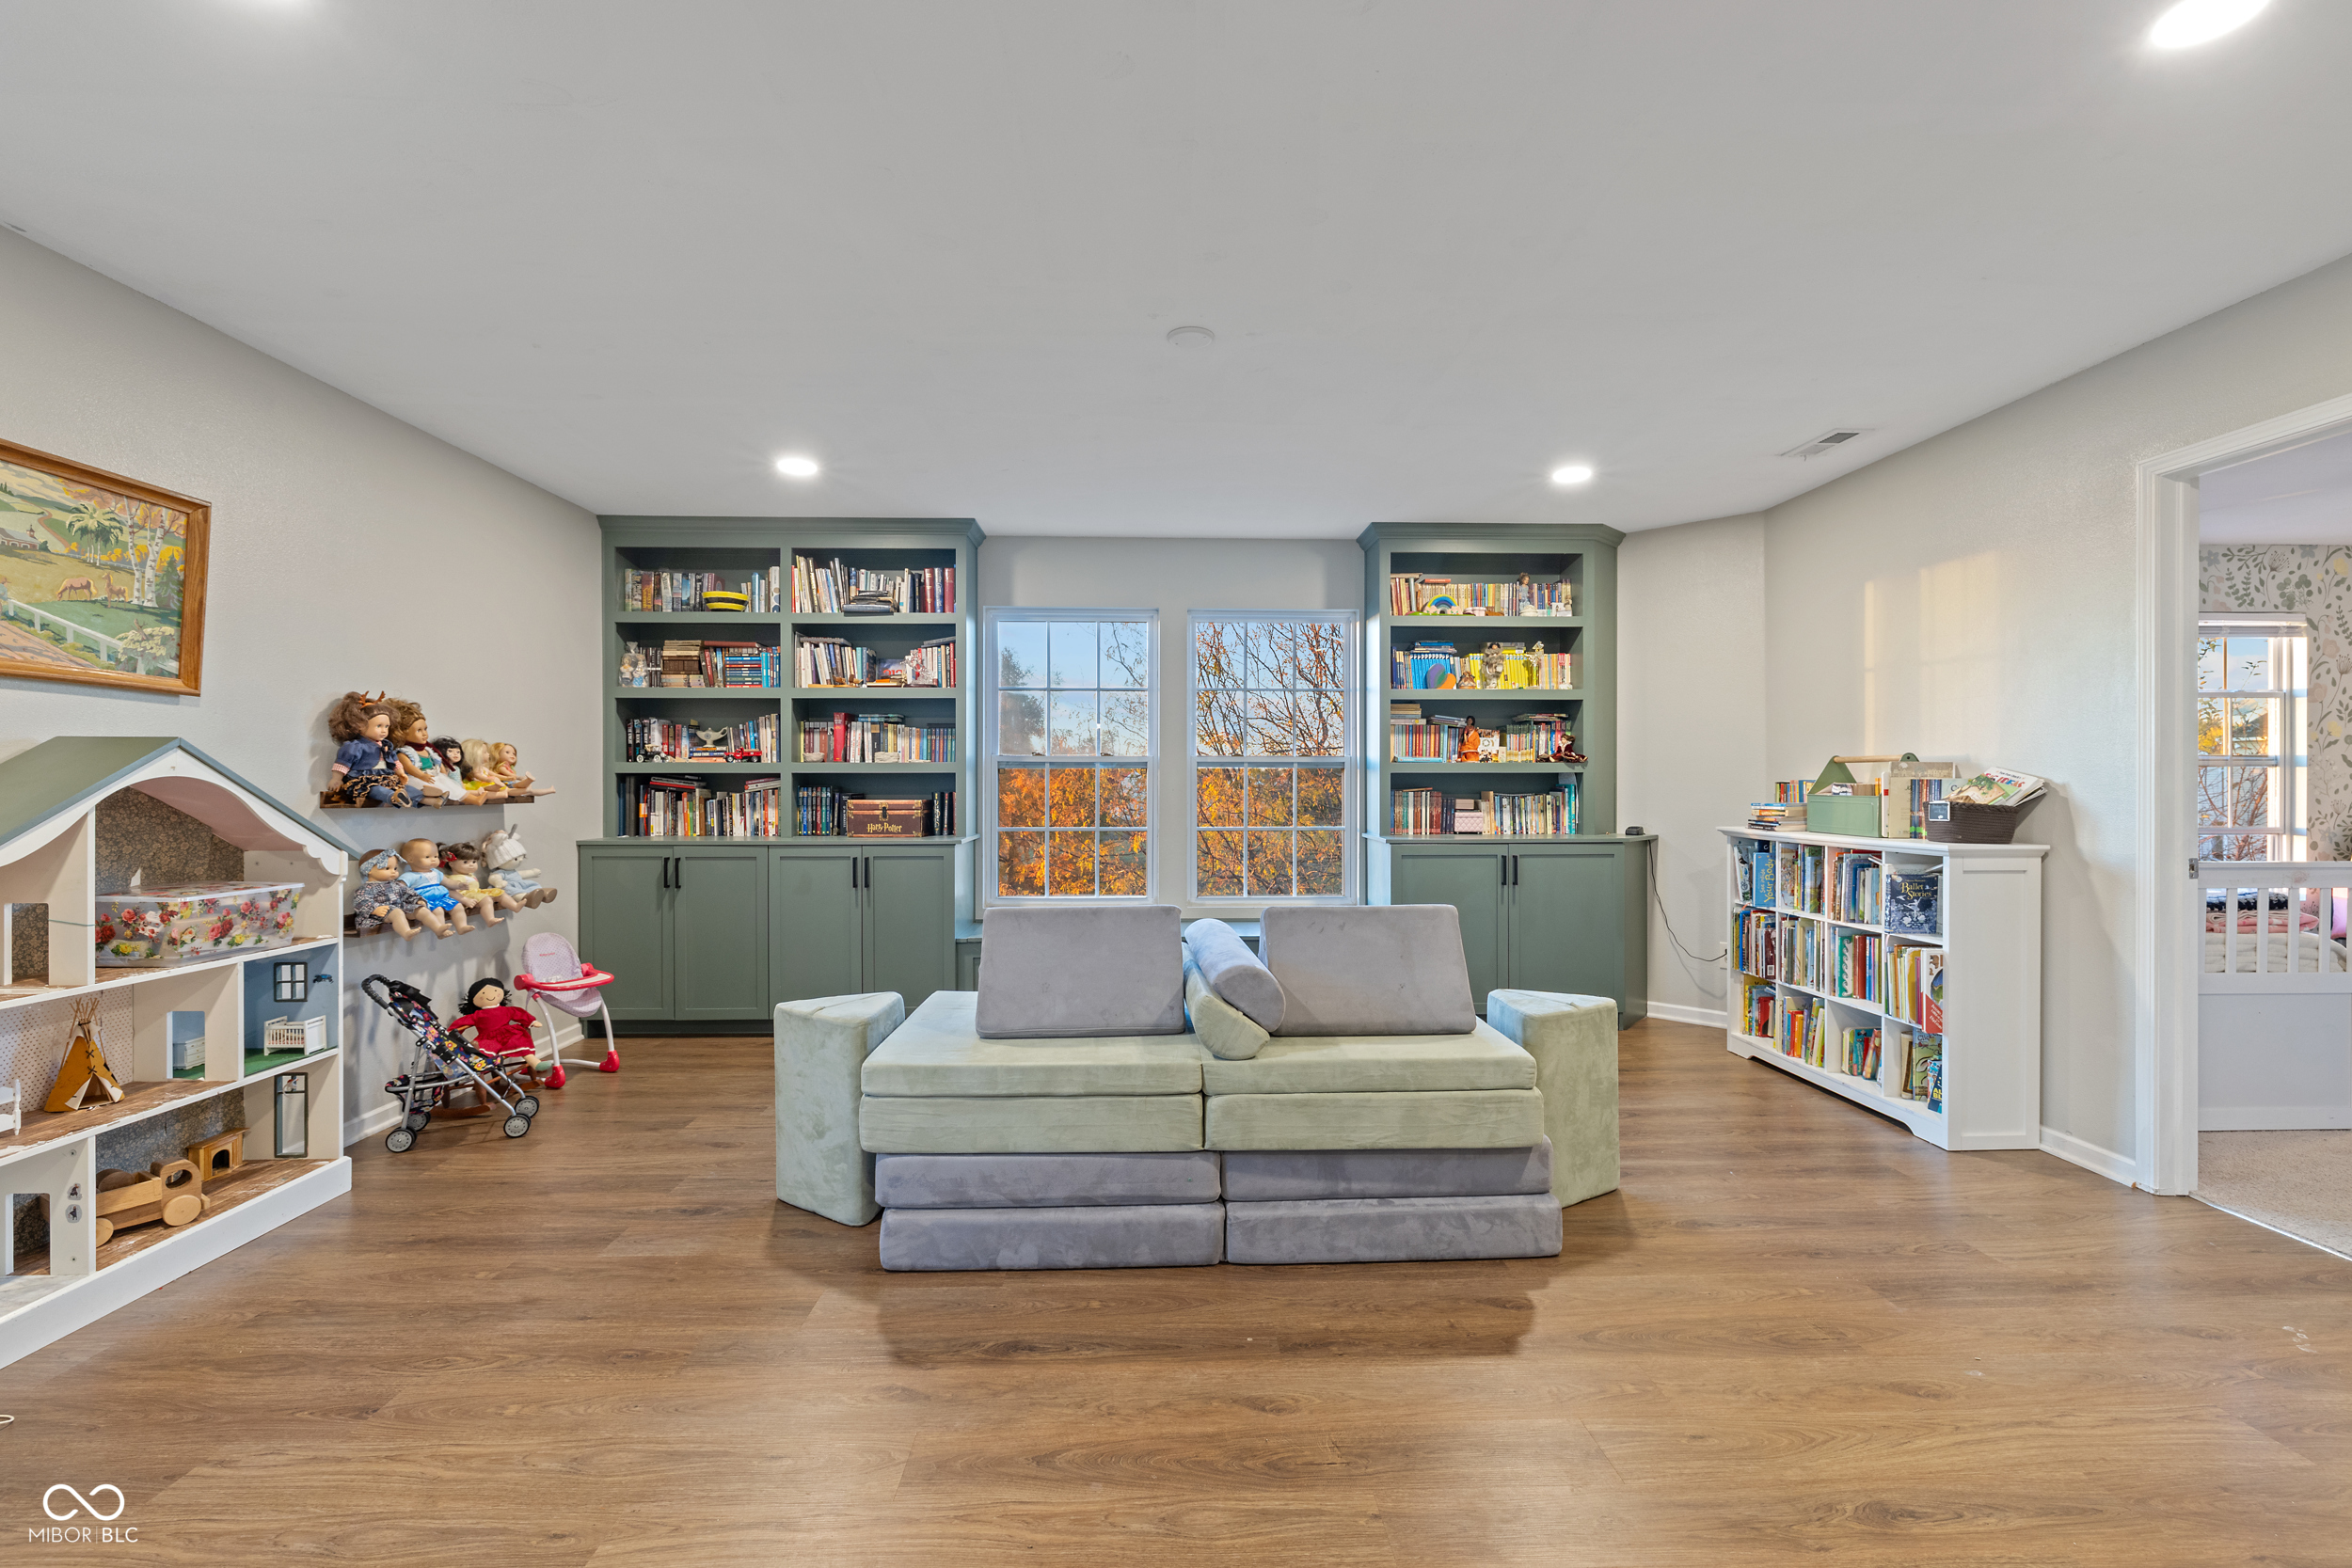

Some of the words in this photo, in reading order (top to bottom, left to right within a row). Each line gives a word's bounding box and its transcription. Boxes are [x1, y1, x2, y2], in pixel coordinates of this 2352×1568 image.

[1996, 776, 2026, 788] IDEAS
[866, 823, 883, 833] Harry
[883, 822, 902, 833] Potter
[1764, 859, 1776, 881] Body
[1764, 881, 1775, 903] Your
[1899, 881, 1924, 893] Ballet
[1907, 890, 1931, 900] Stories
